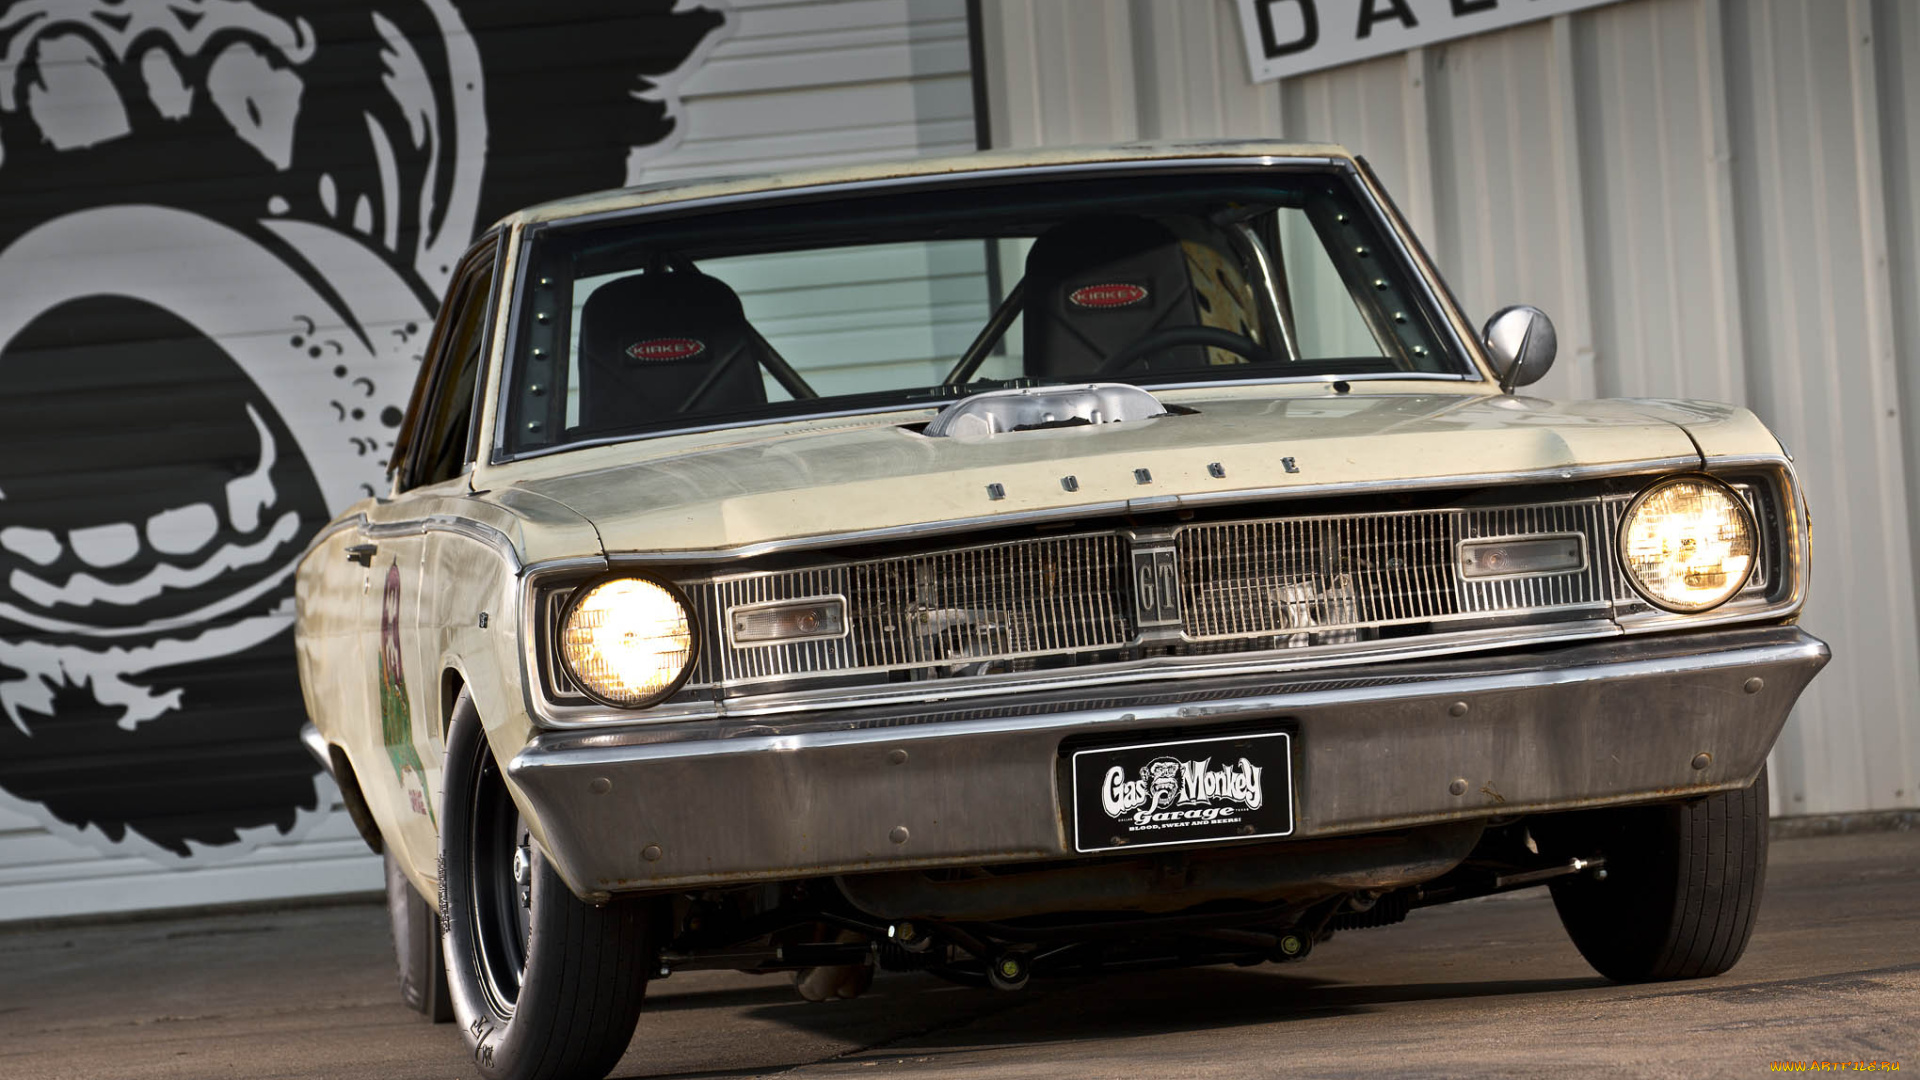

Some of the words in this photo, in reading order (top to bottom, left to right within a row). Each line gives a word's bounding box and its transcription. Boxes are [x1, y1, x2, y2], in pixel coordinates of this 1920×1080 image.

[1254, 0, 1501, 59] DA
[1077, 288, 1139, 300] KIRKEY
[633, 343, 696, 355] KIRKEY
[986, 456, 1300, 500] DODGE
[1138, 561, 1174, 612] GT
[1102, 766, 1149, 818] Gas
[1177, 757, 1263, 810] Monkey
[1161, 821, 1189, 829] SWEAT
